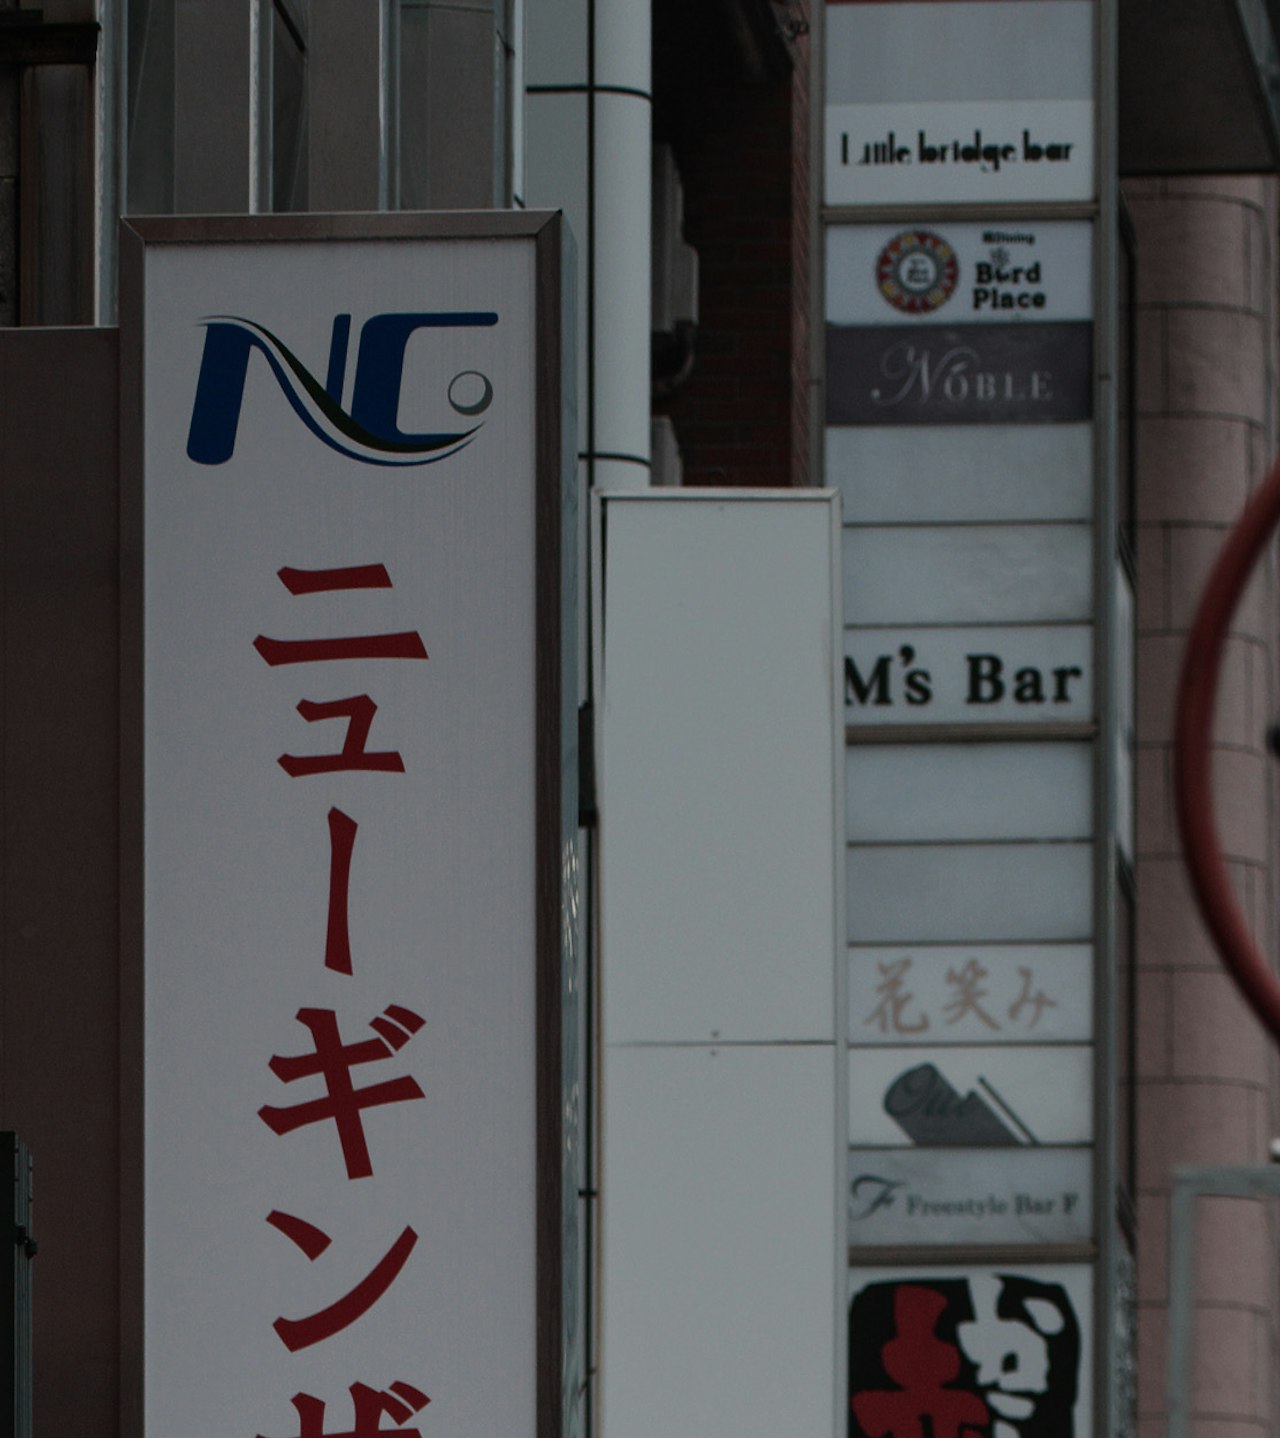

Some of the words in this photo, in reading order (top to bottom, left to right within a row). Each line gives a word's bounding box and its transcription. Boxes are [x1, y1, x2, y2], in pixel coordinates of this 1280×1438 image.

[1023, 128, 1074, 162] bar
[972, 287, 1047, 310] Place
[844, 644, 932, 707] M's
[965, 653, 1083, 707] Bar
[864, 955, 1058, 1035] 花笑み
[1014, 1193, 1054, 1216] Bar
